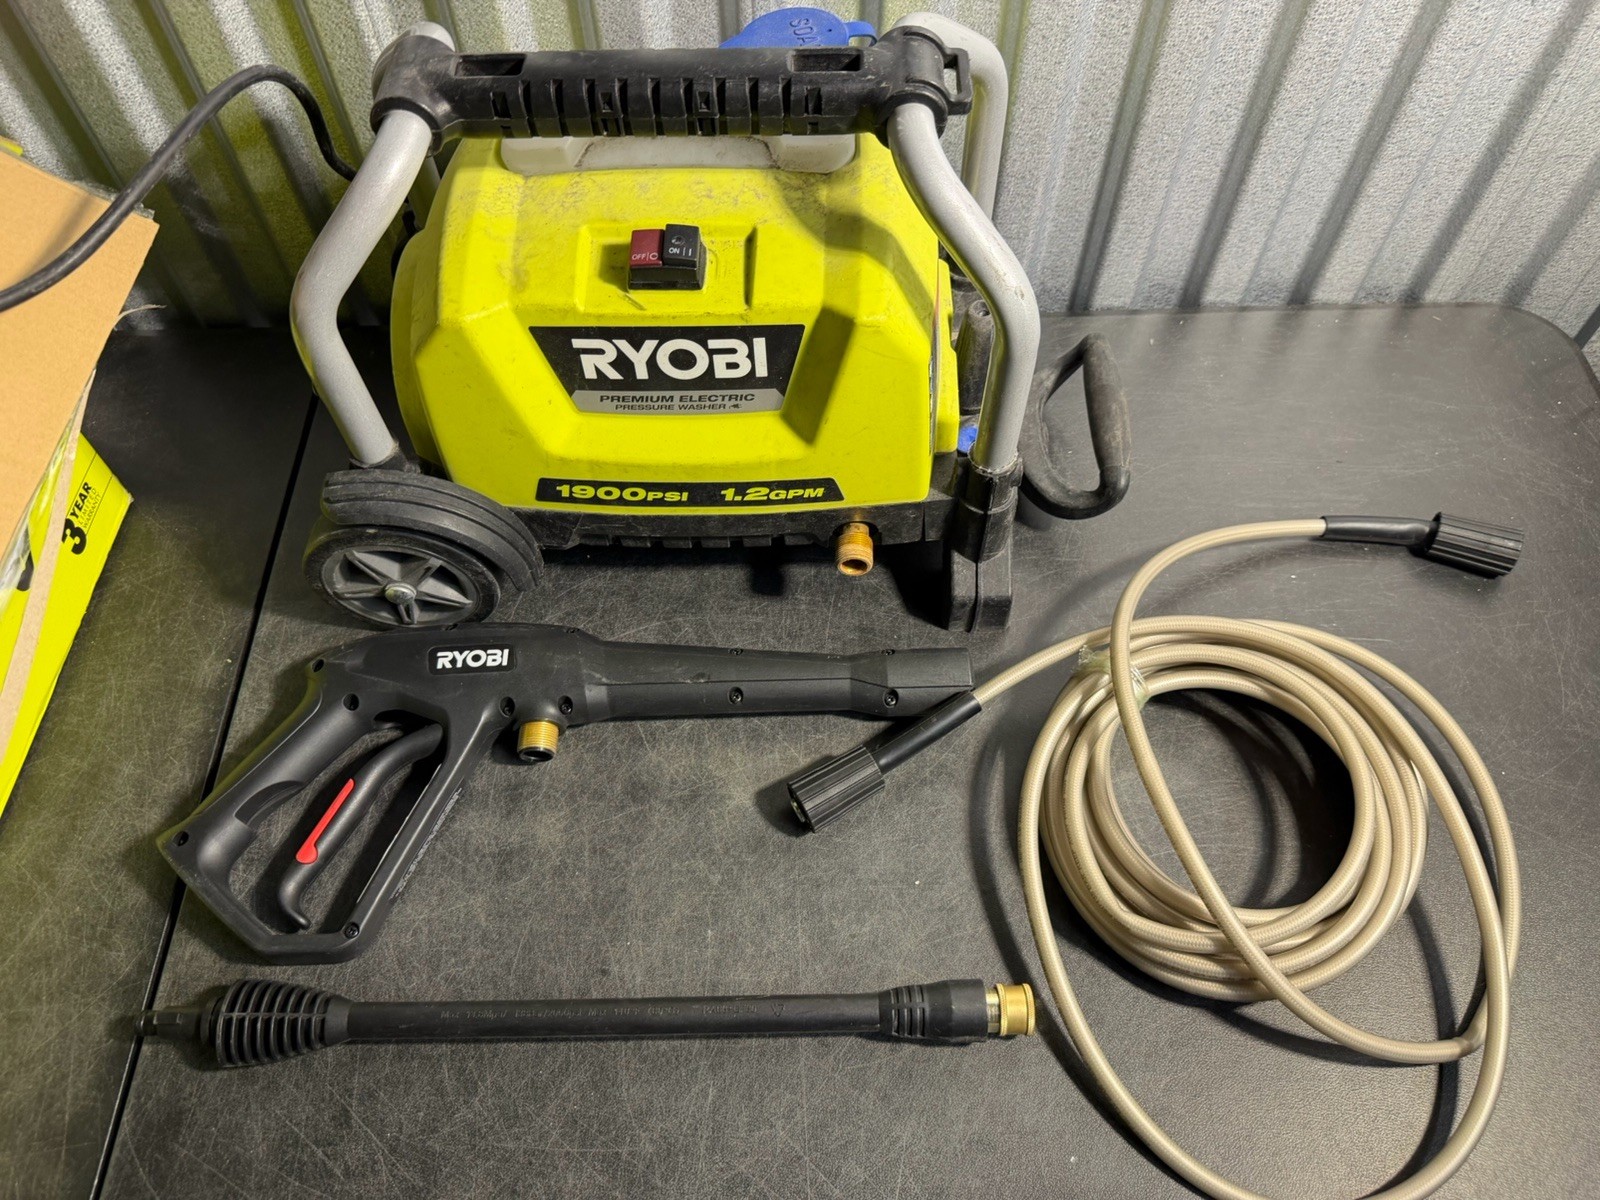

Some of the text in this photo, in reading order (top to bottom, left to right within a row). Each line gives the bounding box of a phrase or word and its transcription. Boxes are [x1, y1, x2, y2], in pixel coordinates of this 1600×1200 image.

[789, 18, 821, 47] SOA
[668, 247, 681, 255] ON
[572, 337, 769, 381] RYOBI
[599, 393, 756, 404] PREMIUM ELECTRIC
[615, 403, 727, 412] PRESSURE WASHER
[556, 484, 825, 502] 1900PSI 1.2GPM
[61, 481, 92, 555] 3 YEAR
[78, 488, 97, 525] LIMITED
[83, 493, 102, 528] WARRANTY
[436, 648, 510, 670] RYOBI
